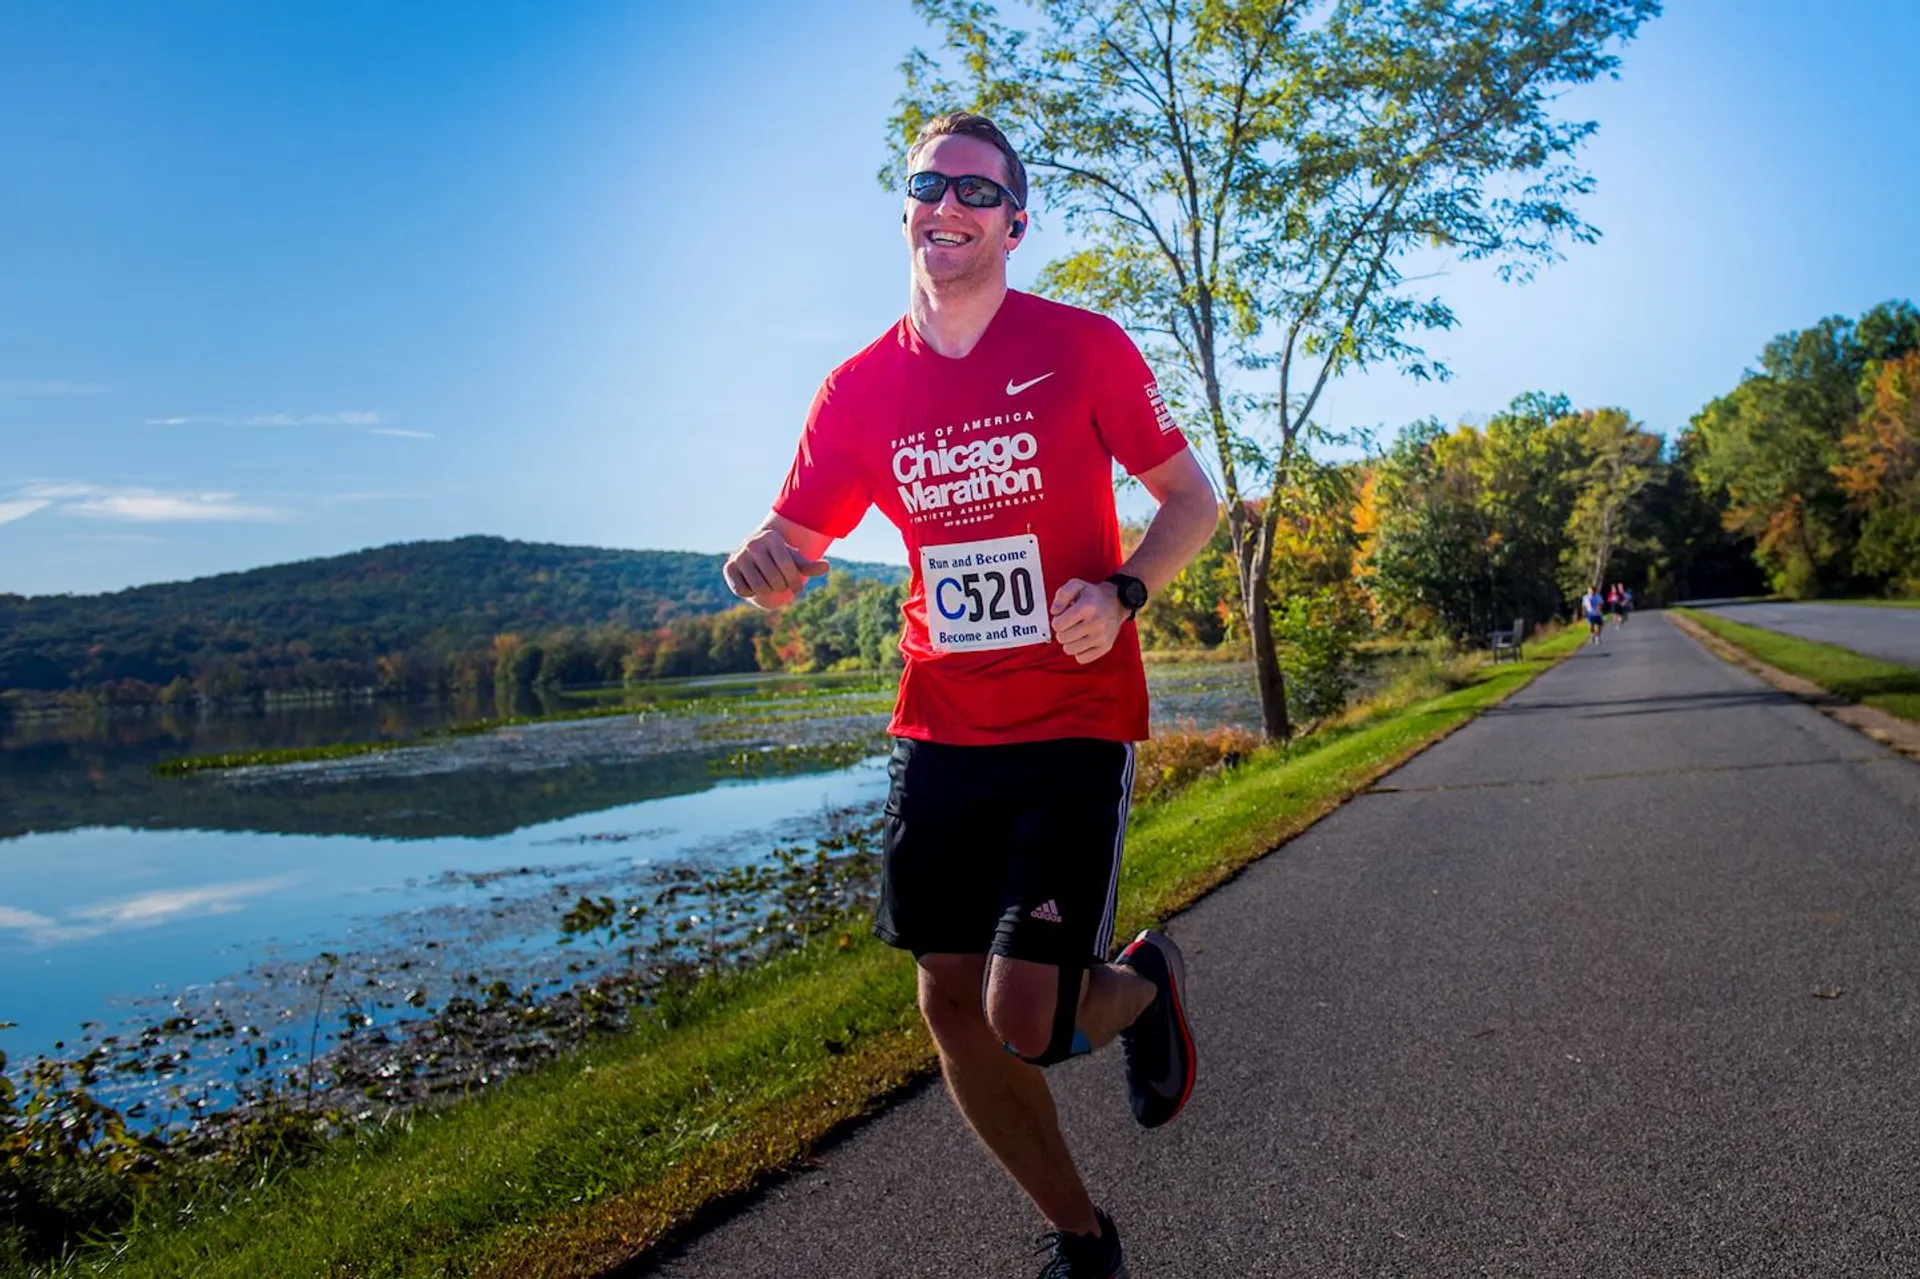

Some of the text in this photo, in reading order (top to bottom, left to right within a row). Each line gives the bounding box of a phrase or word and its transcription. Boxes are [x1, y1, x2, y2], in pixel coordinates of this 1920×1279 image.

[935, 426, 954, 437] OF
[962, 411, 1034, 433] AMERICA
[892, 432, 1038, 484] Chicago
[897, 466, 1043, 515] Marathon
[960, 493, 1046, 515] ANNIVERSARY
[929, 550, 1028, 570] Run and Become
[936, 567, 1035, 623] C520
[939, 624, 1038, 644] Become and Run
[1030, 910, 1062, 923] adidas
